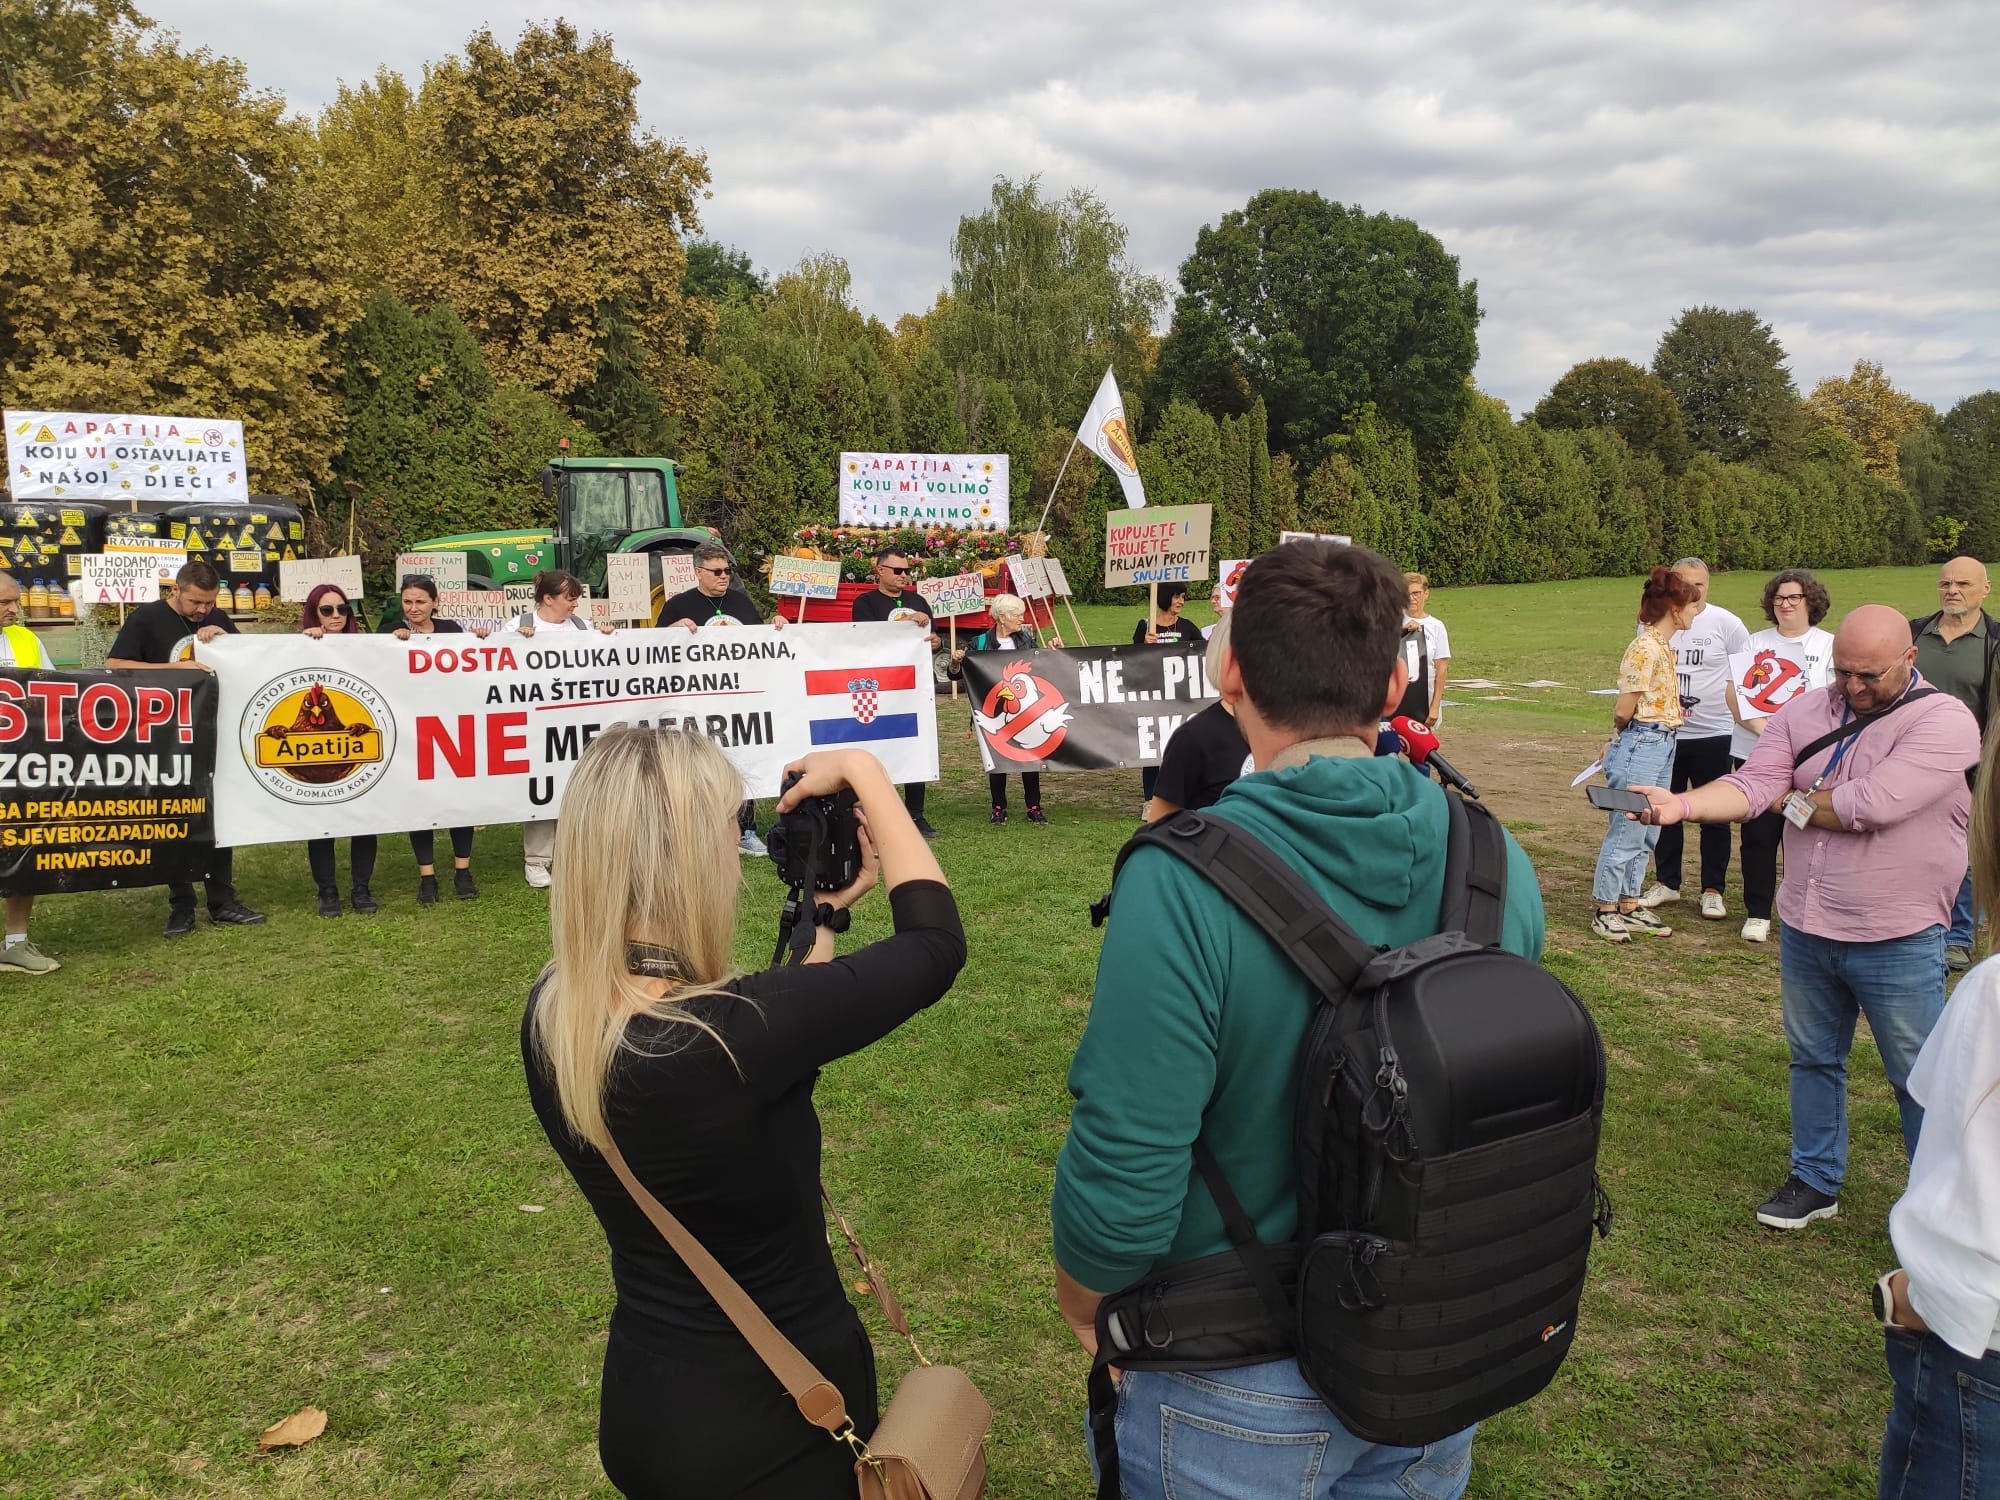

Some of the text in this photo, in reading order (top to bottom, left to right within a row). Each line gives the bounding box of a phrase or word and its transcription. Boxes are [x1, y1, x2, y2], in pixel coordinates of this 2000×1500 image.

[64, 421, 181, 438] APATIJA
[25, 446, 232, 464] KOJU VI OSTAVLJATE
[872, 459, 952, 473] APATIJA
[39, 467, 212, 489] NAŠOJ DJECI
[853, 479, 990, 496] KOJU MI VOLIMO
[873, 504, 973, 519] I BRANIMO
[1110, 521, 1190, 543] KUPUJETE I
[1109, 538, 1170, 557] TRUJETE
[83, 557, 97, 569] MI
[105, 556, 157, 569] HODAMO
[233, 553, 260, 561] CAUTION
[441, 557, 462, 565] NAM
[1110, 550, 1208, 573] PRLJAVI PROFIT
[89, 567, 151, 579] UZDIGNUTE
[1132, 566, 1190, 584] SNUJETE
[94, 578, 135, 588] GLAVE
[920, 581, 944, 595] STOP
[98, 588, 111, 602] A
[116, 587, 134, 602] VI
[932, 587, 983, 603] APATIJA
[942, 602, 955, 614] NE
[408, 640, 797, 674] DOSTA ODLUKA U IME GRAĐANA,
[1685, 649, 1704, 665] TO!
[255, 673, 377, 711] STOP FARMI PILIĆA
[485, 672, 741, 705] A NA ŠTETU GRAĐANA!
[275, 735, 366, 761] Apatija
[415, 711, 530, 781] NE
[0, 753, 192, 788] ZGRADNJI
[268, 771, 374, 799] SELO DOMAĆIH KOKA
[528, 775, 554, 806] U
[26, 799, 158, 819] PERADARSKIH
[161, 797, 206, 815] FARMI
[3, 823, 189, 847] SJEVEROZAPADNOJ
[36, 849, 152, 871] HRVATSKOJ!
